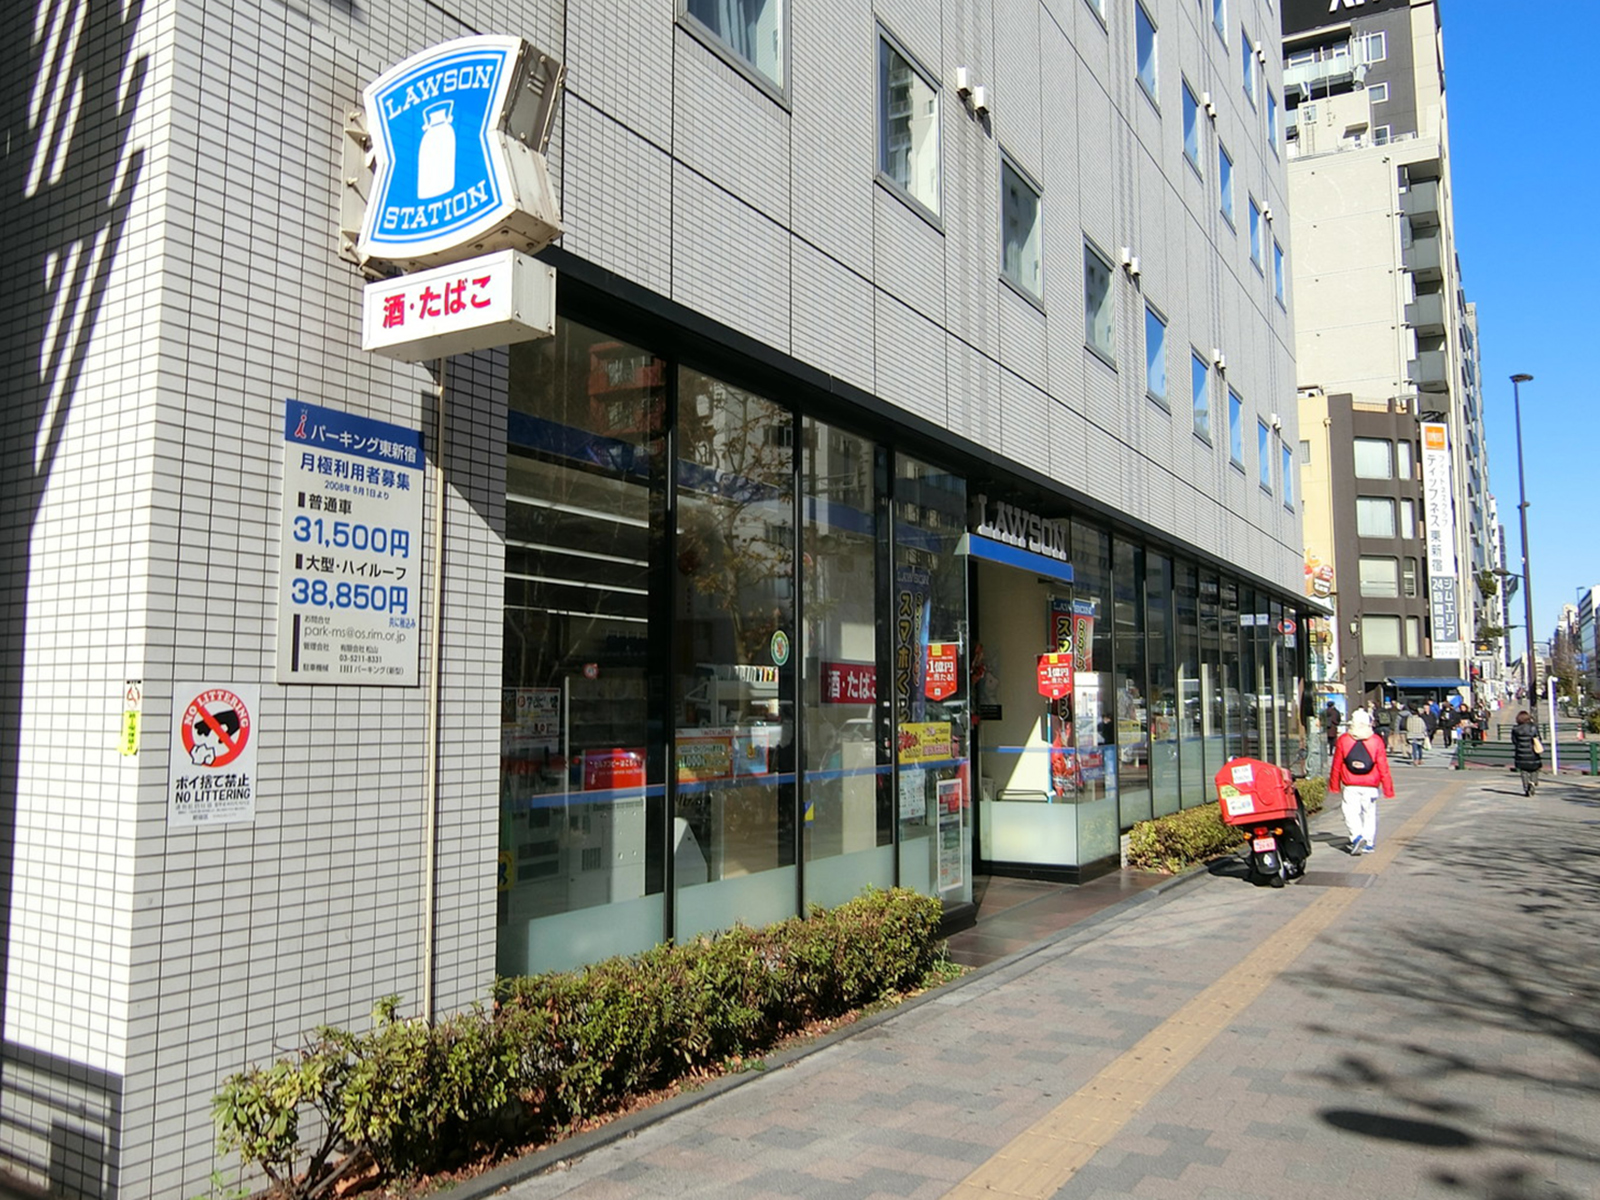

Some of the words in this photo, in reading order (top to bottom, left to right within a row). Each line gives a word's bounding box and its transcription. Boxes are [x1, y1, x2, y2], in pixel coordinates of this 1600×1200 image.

[386, 65, 494, 120] LAWSON
[383, 179, 489, 231] STATION
[382, 275, 491, 329] 酒・たばこ
[300, 452, 411, 491] 月極利用者募集
[308, 494, 353, 515] 普通車
[293, 515, 410, 559] 31,500円
[977, 493, 1067, 561] LAWSON
[291, 577, 408, 615] 38,850円
[184, 705, 198, 726] NO
[197, 690, 249, 728] LITTERING
[175, 773, 250, 790] ポイ捨て禁止
[175, 791, 191, 804] NO
[195, 788, 251, 802] LITTERING
